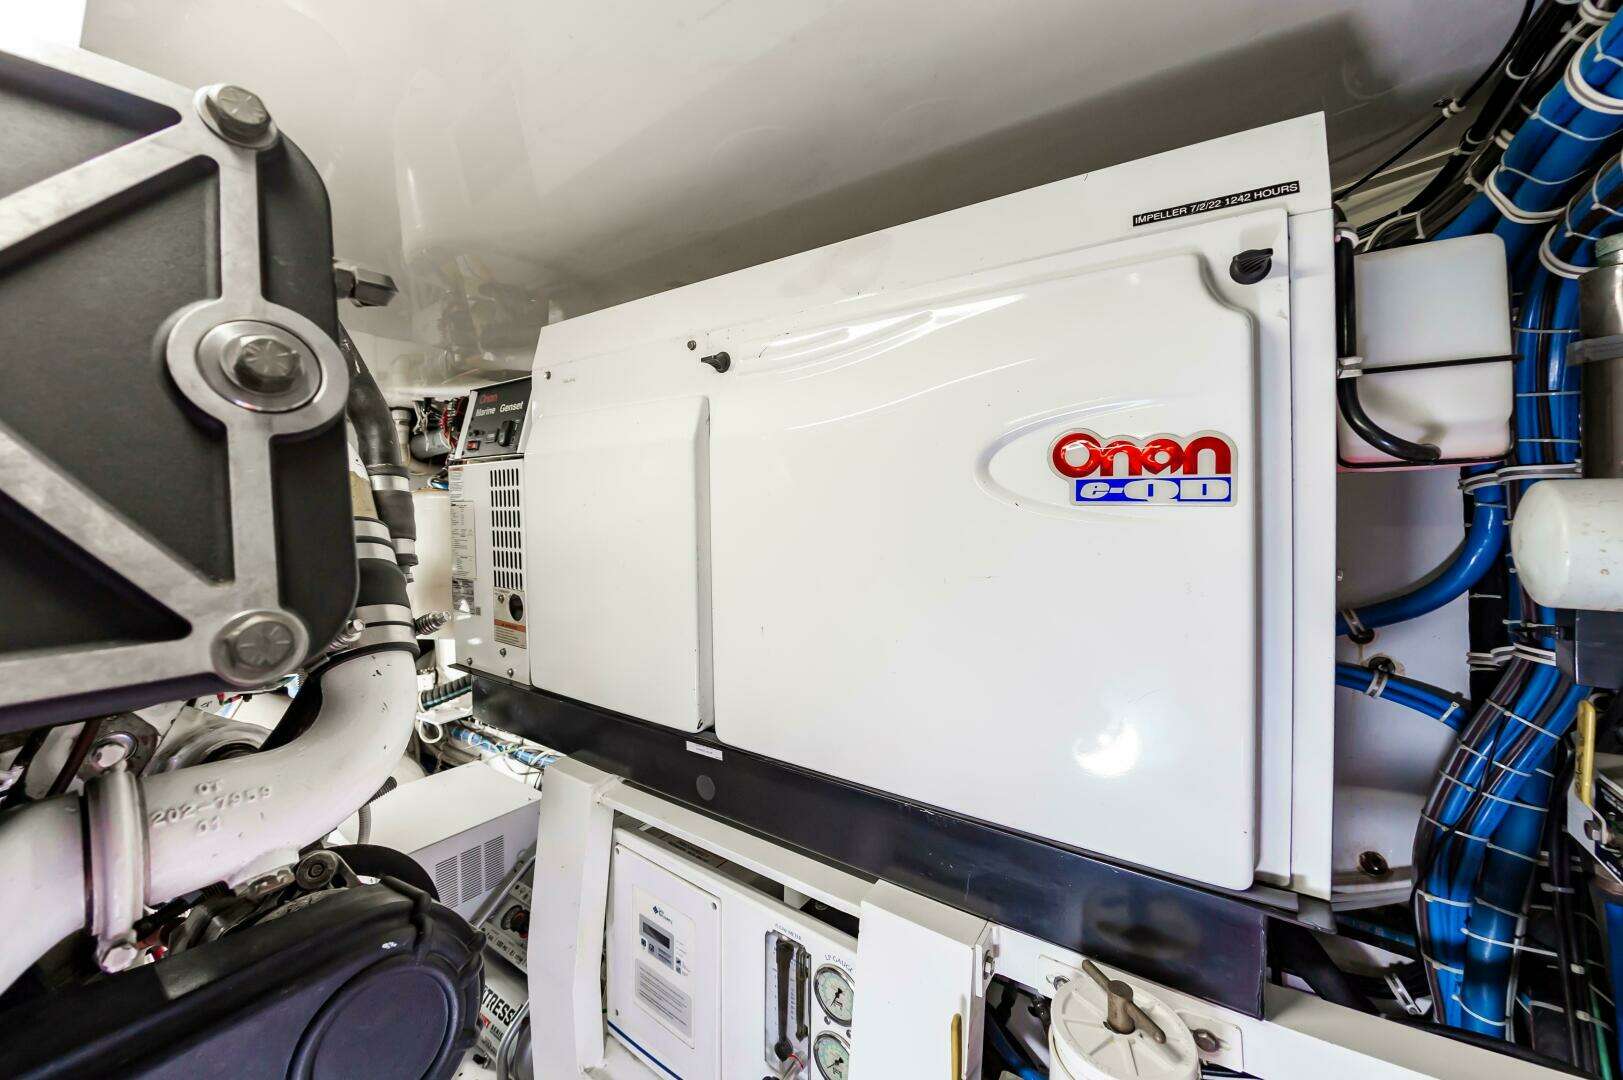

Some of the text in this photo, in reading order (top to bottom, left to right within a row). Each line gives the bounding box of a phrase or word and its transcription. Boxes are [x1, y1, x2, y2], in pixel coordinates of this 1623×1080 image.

[1134, 183, 1299, 225] IMPELLER 7/2/22 1242 HOURS
[475, 401, 524, 417] Marine Genset
